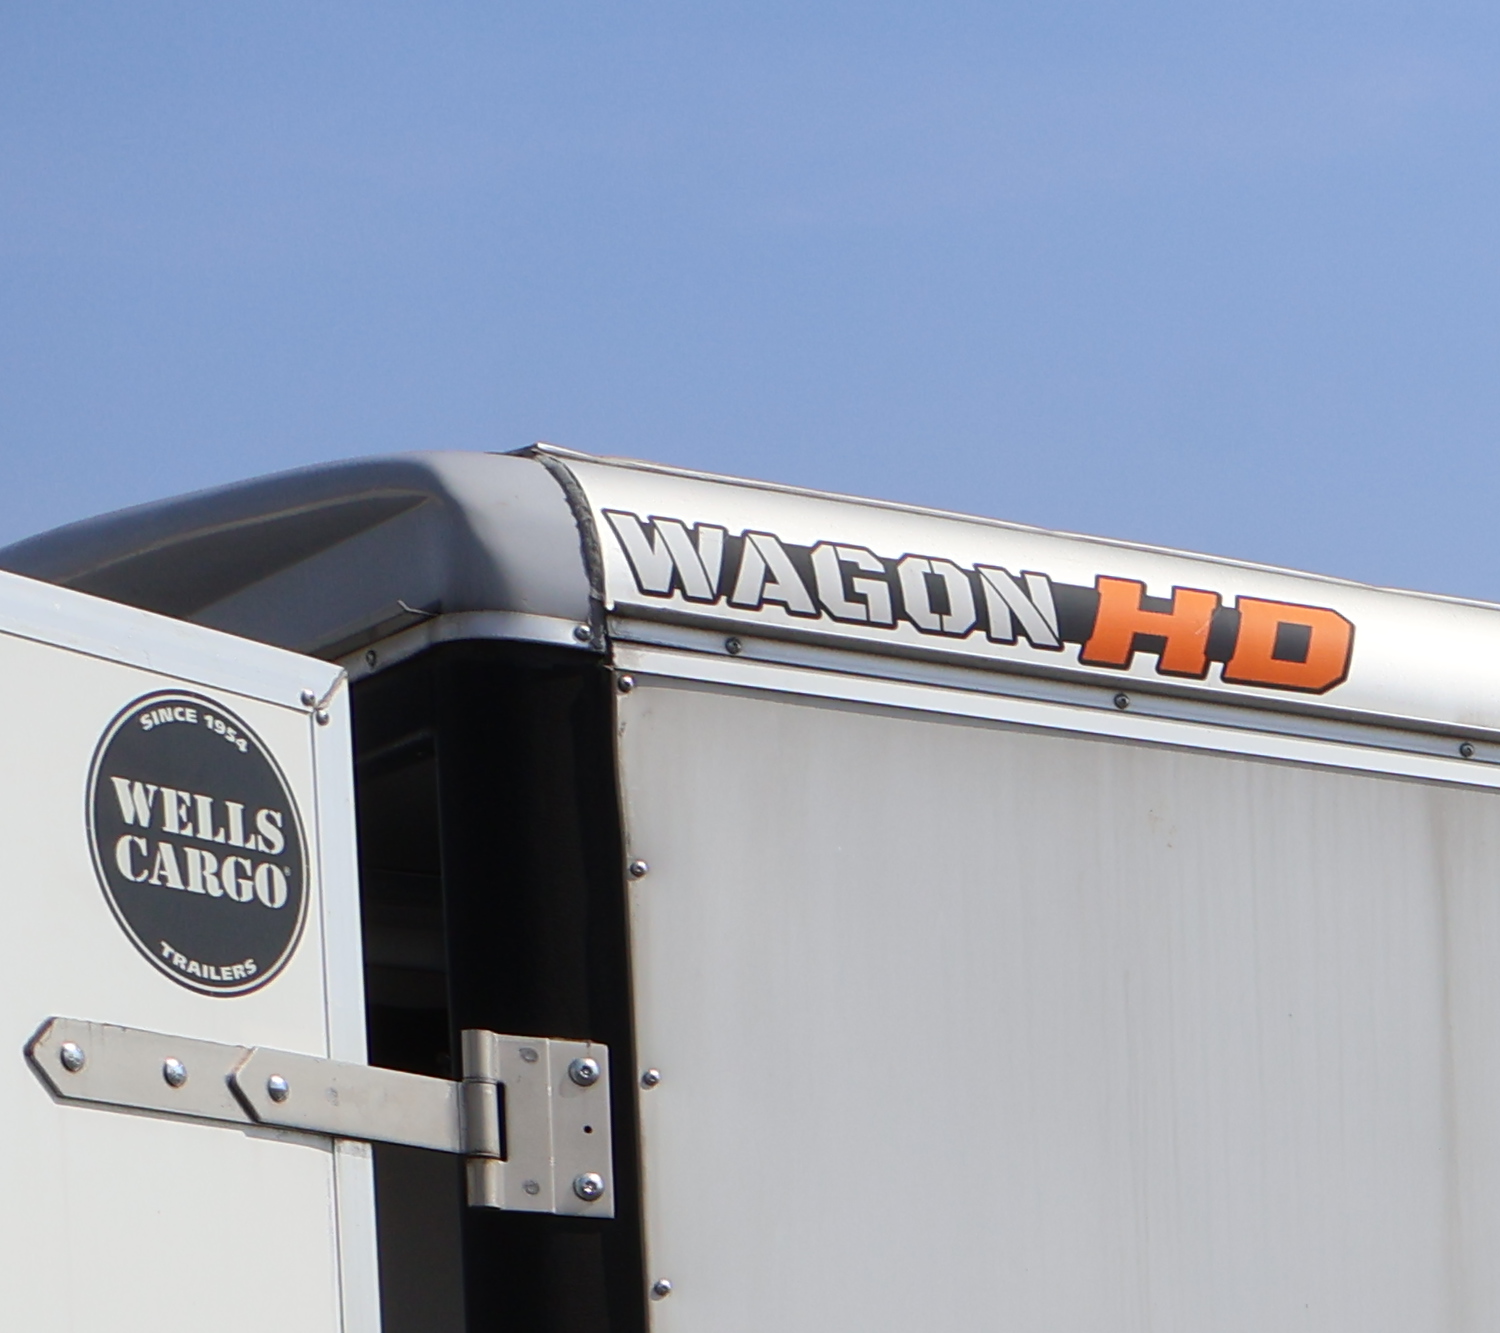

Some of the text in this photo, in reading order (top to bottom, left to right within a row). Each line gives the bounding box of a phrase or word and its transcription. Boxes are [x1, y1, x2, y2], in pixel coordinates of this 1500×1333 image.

[602, 509, 1356, 695] WAGON HD
[139, 705, 249, 754] SINCE 1954
[110, 775, 286, 856] WELLS
[114, 834, 289, 910] CARGO
[160, 939, 258, 981] TRAILERS
